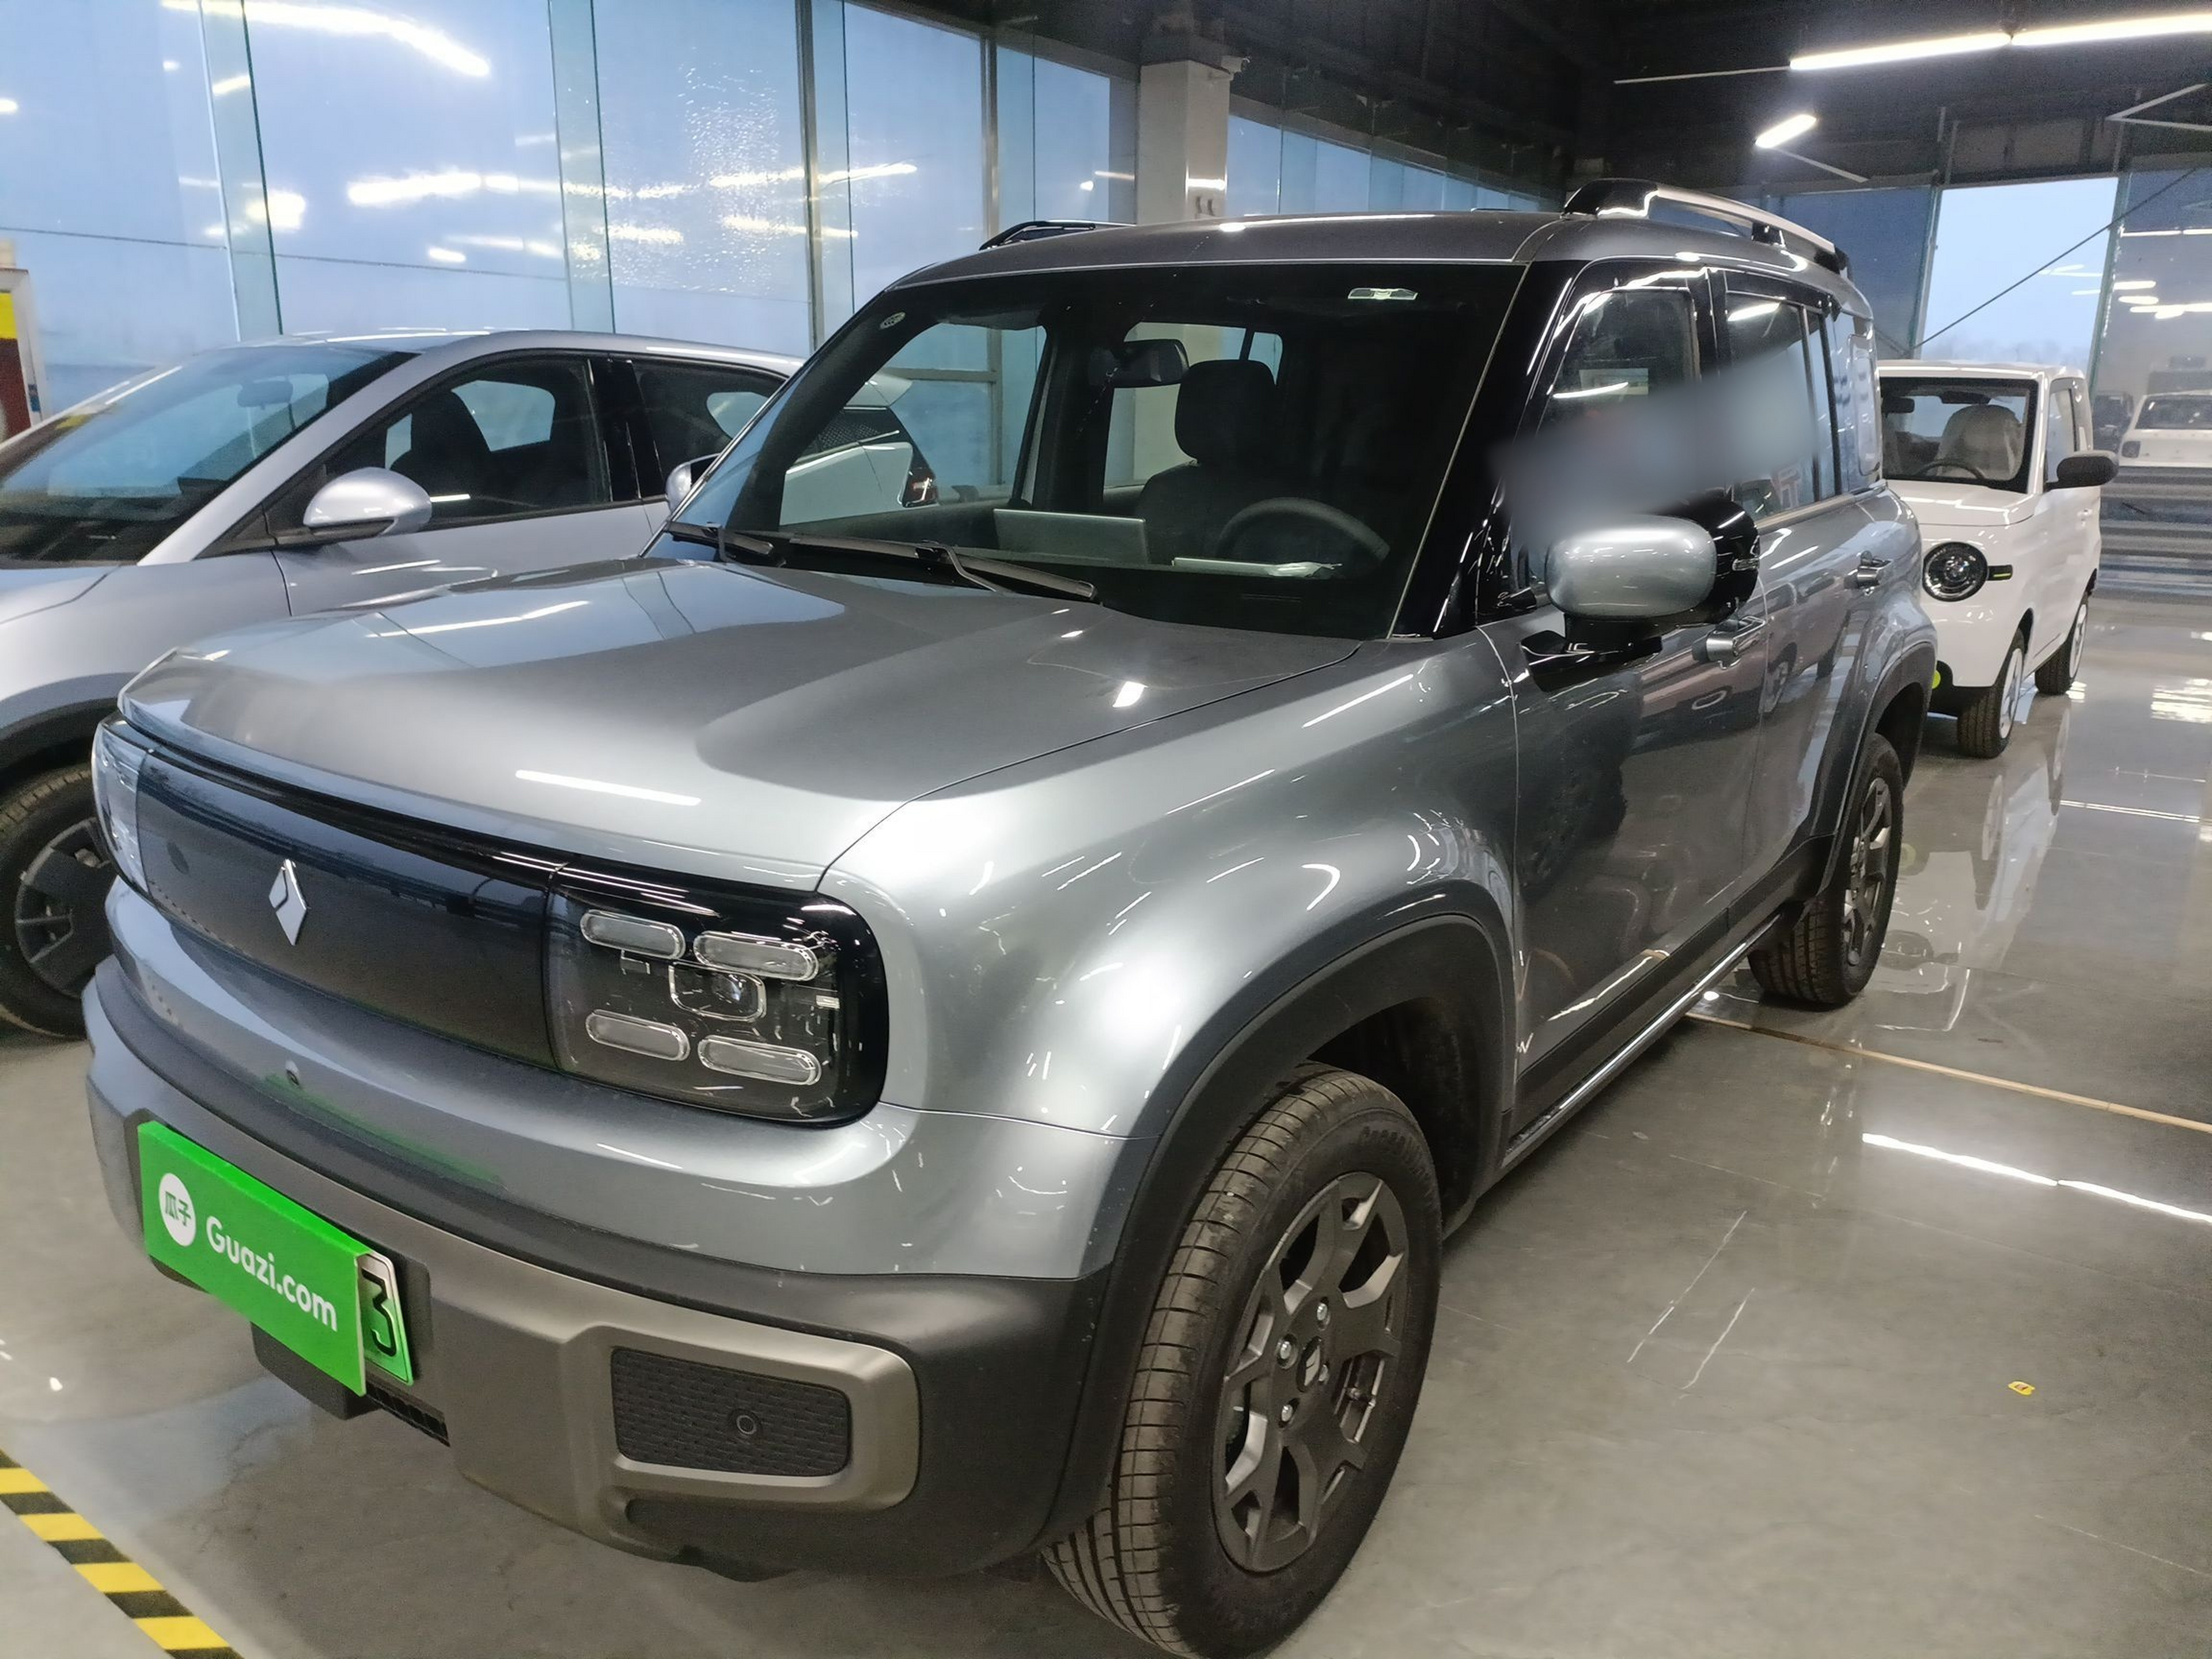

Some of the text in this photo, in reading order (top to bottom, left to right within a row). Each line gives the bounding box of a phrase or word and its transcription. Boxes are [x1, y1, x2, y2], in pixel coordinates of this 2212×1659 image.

[165, 1190, 192, 1226] 瓜子
[206, 1215, 338, 1332] Guazi.com
[361, 1267, 397, 1358] 3
